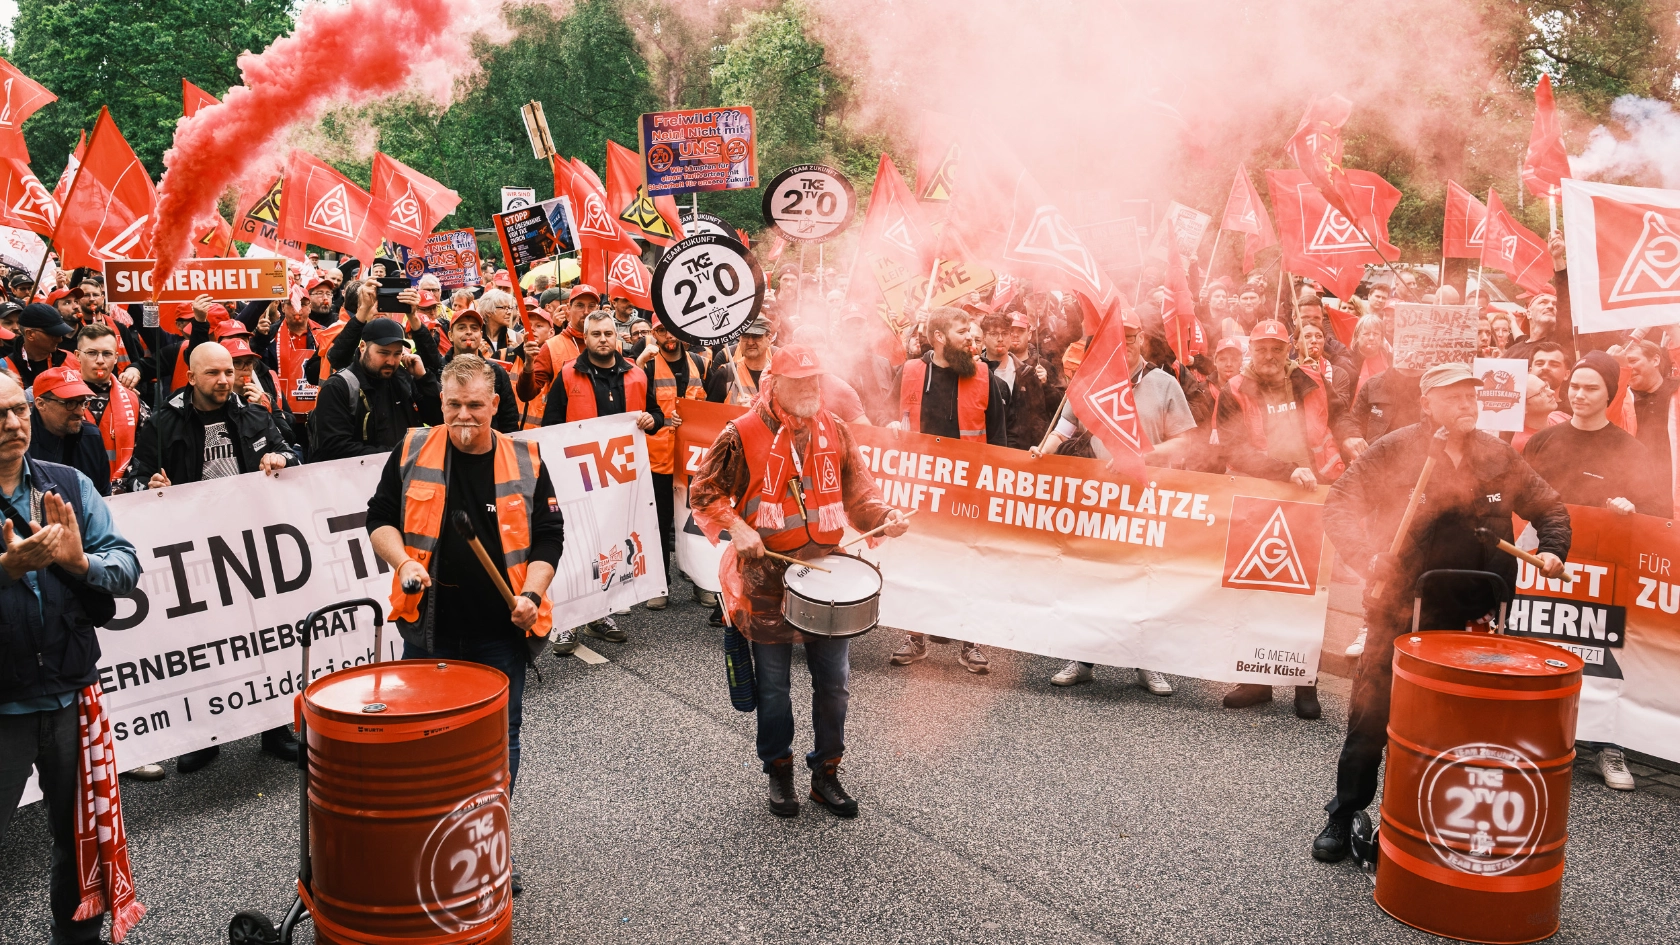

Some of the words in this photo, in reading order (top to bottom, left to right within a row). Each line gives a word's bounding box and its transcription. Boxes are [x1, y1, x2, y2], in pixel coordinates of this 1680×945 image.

[654, 110, 741, 128] Freiwild???
[652, 128, 685, 141] Nein!
[688, 126, 722, 138] Nicht
[724, 125, 745, 135] mit
[679, 141, 719, 156] UNS
[725, 175, 754, 184] Zukunft
[789, 165, 808, 175] TEAM
[809, 165, 838, 177] ZUKUNFT
[800, 178, 825, 190] TKE
[805, 191, 818, 199] TV
[781, 189, 837, 217] 2.0
[240, 218, 256, 233] IG
[504, 210, 528, 226] STOPP
[427, 230, 467, 245] wild???
[663, 245, 682, 264] TEAM
[681, 235, 717, 250] ZUKUNFT
[427, 253, 457, 265] UNS
[681, 251, 714, 275] TKE
[115, 268, 262, 293] SICHERHEIT
[694, 269, 711, 284] TV
[674, 262, 740, 317] 2.0
[699, 337, 720, 346] TEAM
[720, 336, 729, 344] IG
[728, 319, 754, 340] METALL
[563, 434, 637, 492] TKE
[858, 445, 970, 487] SICHERE
[976, 463, 1216, 527] ARBEITSPLÄTZE,
[1486, 493, 1502, 503] TKE
[485, 503, 497, 512] TK
[876, 478, 946, 513] UNFT
[951, 501, 980, 520] UND
[987, 497, 1167, 548] EINKOMMEN
[633, 554, 647, 578] all
[1638, 552, 1672, 577] FÜR
[1515, 556, 1609, 598] UNFT
[1635, 576, 1680, 615] ZU
[1507, 598, 1619, 643] HERN.
[97, 605, 360, 695] ERNBETRIEBSRAT
[1254, 647, 1266, 660] IG
[1267, 648, 1308, 665] METALL
[1236, 660, 1272, 675] Bezirk
[1273, 664, 1306, 678] Küste
[114, 708, 172, 742] sam
[1472, 788, 1498, 805] TV
[1445, 786, 1526, 833] 2.0
[463, 812, 495, 844] TKE
[474, 836, 492, 858] TV
[450, 830, 507, 894] 2.0
